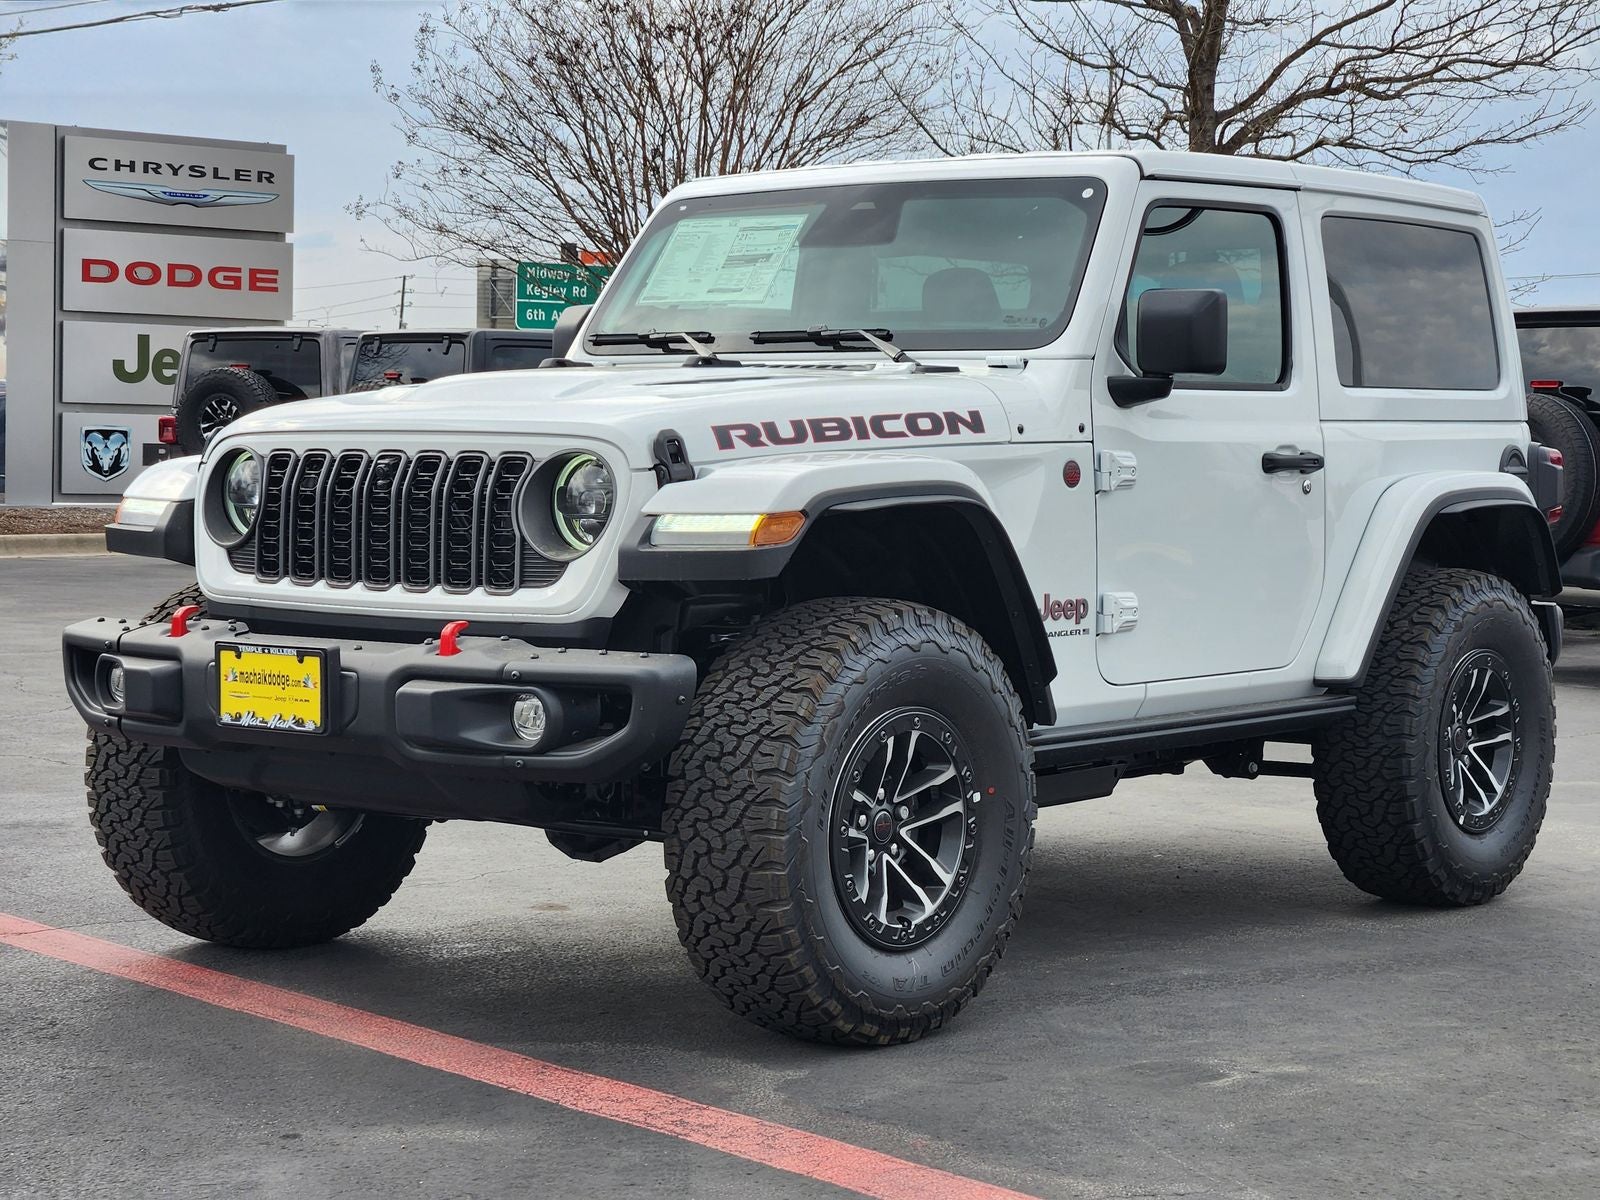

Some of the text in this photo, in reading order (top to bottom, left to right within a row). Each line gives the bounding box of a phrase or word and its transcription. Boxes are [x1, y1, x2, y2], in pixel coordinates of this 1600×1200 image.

[88, 157, 276, 184] CHRYSLER
[81, 258, 279, 293] DODGE
[526, 267, 570, 283] Midway
[526, 283, 567, 299] Kegley
[572, 285, 587, 298] Rd
[526, 309, 545, 321] 6th
[112, 334, 182, 385] Je
[710, 409, 986, 451] RUBICON
[1040, 593, 1088, 624] Jeep
[1046, 628, 1081, 637] ANGLER
[239, 669, 301, 690] machaikdodge.com
[241, 711, 298, 729] Mac Haik
